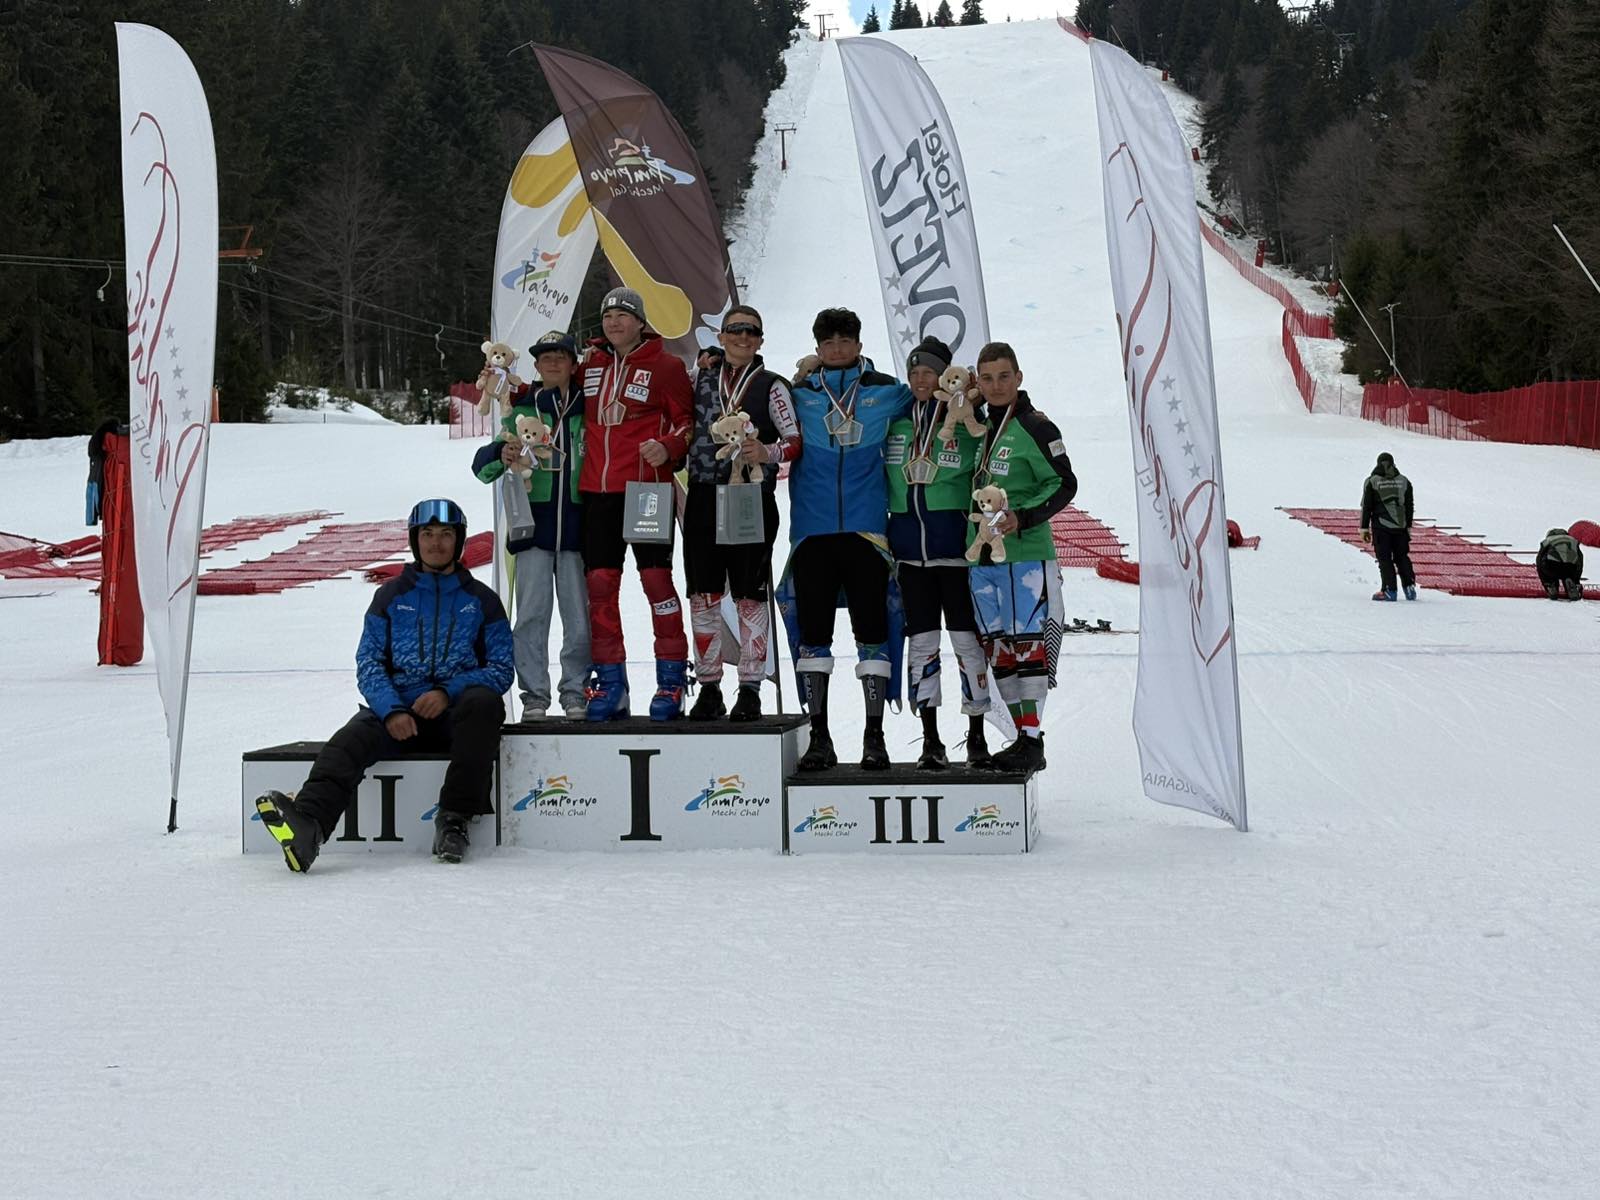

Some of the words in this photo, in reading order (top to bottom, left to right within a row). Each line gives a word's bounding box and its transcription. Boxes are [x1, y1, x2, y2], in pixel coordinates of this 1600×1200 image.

[770, 387, 794, 428] HALTI
[540, 809, 565, 817] Mechi
[567, 809, 587, 817] Chal
[711, 809, 737, 817] Mechi
[740, 809, 759, 817] Chal
[868, 796, 945, 844] III
